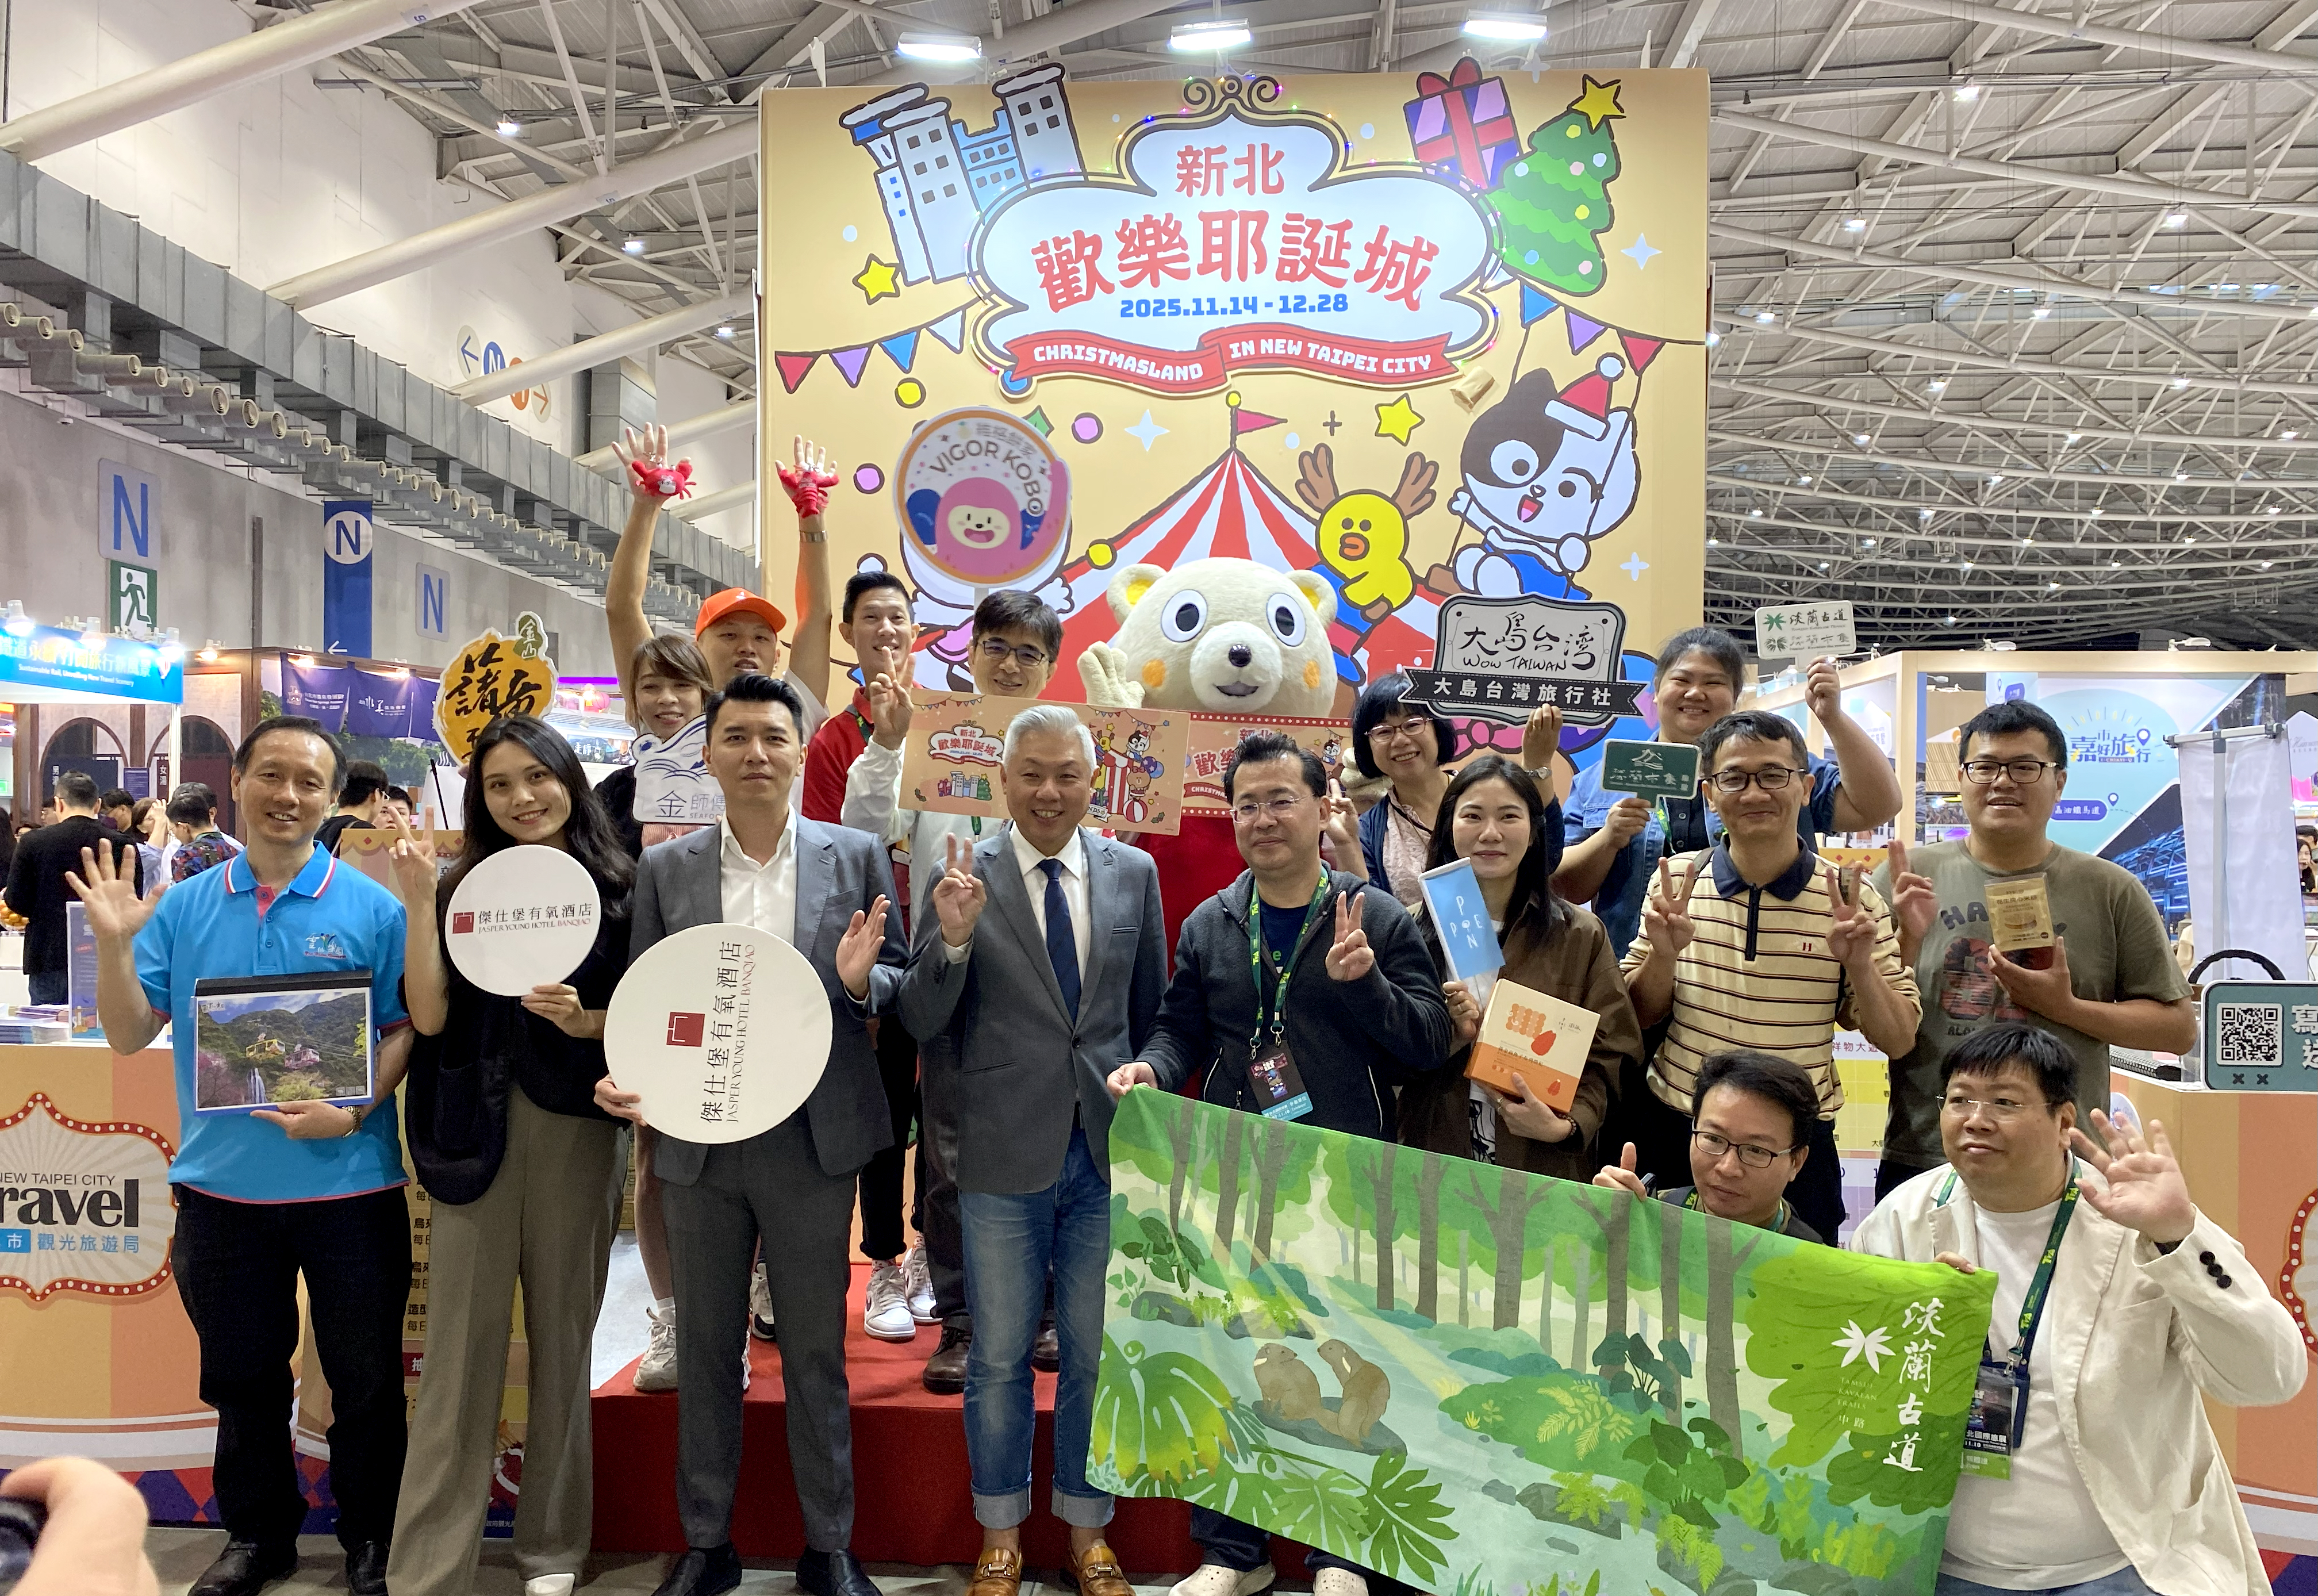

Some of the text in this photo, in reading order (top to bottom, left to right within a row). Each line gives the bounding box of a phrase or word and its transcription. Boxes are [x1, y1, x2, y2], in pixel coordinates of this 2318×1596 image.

[1176, 143, 1284, 198] 新北
[1031, 209, 1440, 313] 歡樂耶誕城
[1120, 296, 1258, 317] 2025.11.14
[1279, 293, 1348, 313] 12.28
[1033, 337, 1432, 381] CHRISTMASLAND IN NEW TAIPEI CITY
[930, 439, 999, 474] VIGOR
[1003, 449, 1043, 515] KOBO
[113, 474, 148, 557] N
[336, 520, 360, 555] N
[423, 574, 443, 632] N
[1506, 655, 1567, 672] TAIWAN
[1433, 679, 1611, 707] 大島台灣旅行社
[938, 738, 997, 757] 歡樂耶誕城
[478, 903, 592, 925] 傑仕堡有氧酒店
[478, 918, 591, 934] JASPER YOUNG HOTEL BANQIAO
[700, 941, 742, 1123] 傑仕堡有氧酒店
[726, 944, 756, 1123] JASPER YOUNG HOTEL BANQIAO
[31, 1173, 76, 1185] TAIPEI
[82, 1175, 116, 1186] CITY
[7, 1233, 139, 1253] 市 觀光旅遊局
[1882, 1297, 1945, 1472] 淡蘭古道
